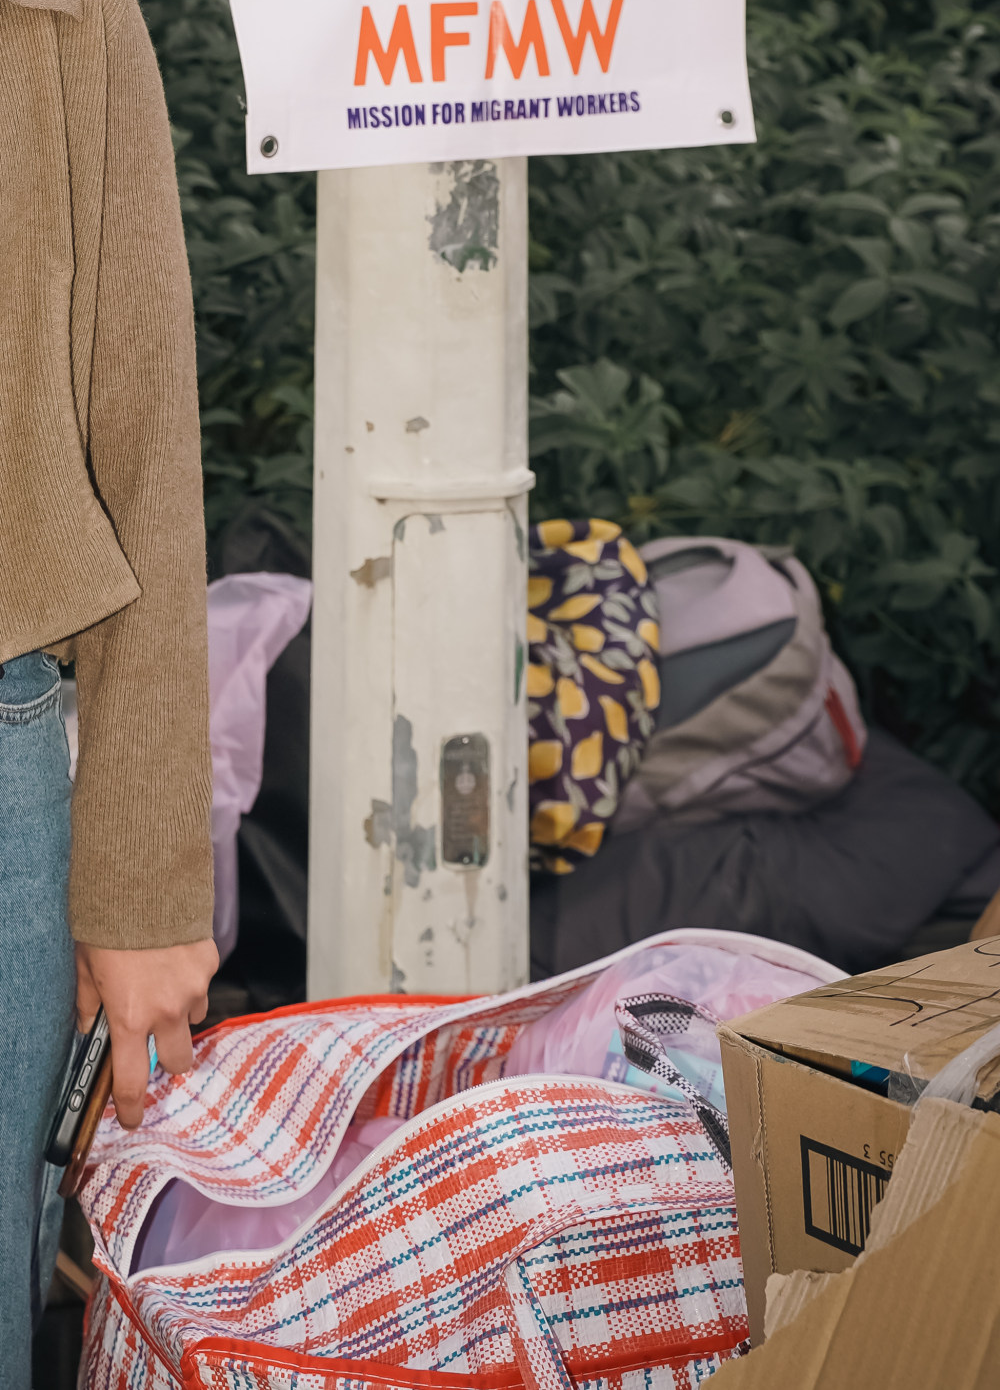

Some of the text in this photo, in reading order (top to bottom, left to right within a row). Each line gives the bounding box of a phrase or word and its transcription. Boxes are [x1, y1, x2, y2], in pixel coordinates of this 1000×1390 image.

[346, 91, 641, 129] MISSION FOR MIGRANT WORKERS
